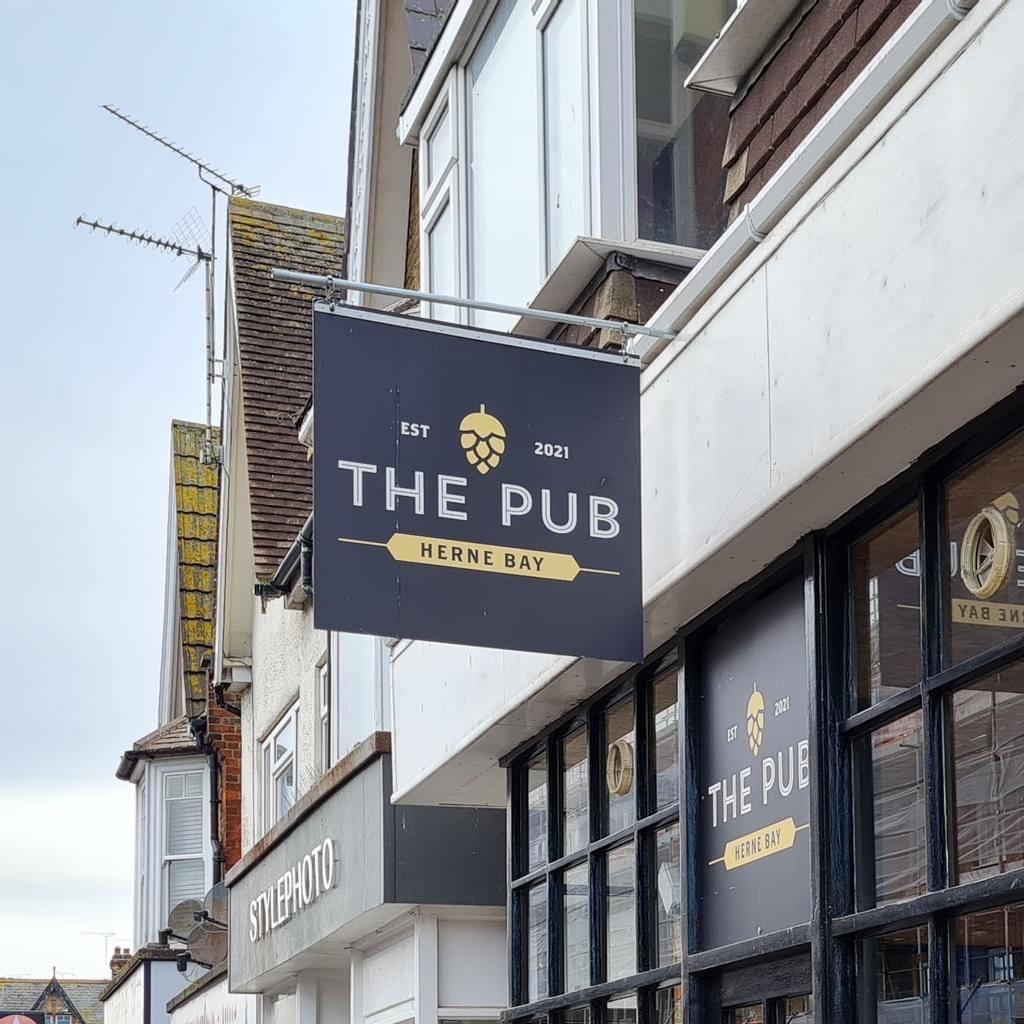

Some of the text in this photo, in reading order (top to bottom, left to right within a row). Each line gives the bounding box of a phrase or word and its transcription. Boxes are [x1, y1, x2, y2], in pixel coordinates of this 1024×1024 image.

[400, 421, 431, 439] EST
[534, 442, 570, 460] 2021
[338, 459, 621, 539] THE PUB
[420, 541, 545, 572] HERNE BAY
[774, 696, 790, 717] 2021
[727, 725, 738, 742] EST
[708, 738, 809, 828] THE PUB
[735, 827, 781, 862] HERNE BAY
[249, 838, 333, 942] STYLEPHOTO
